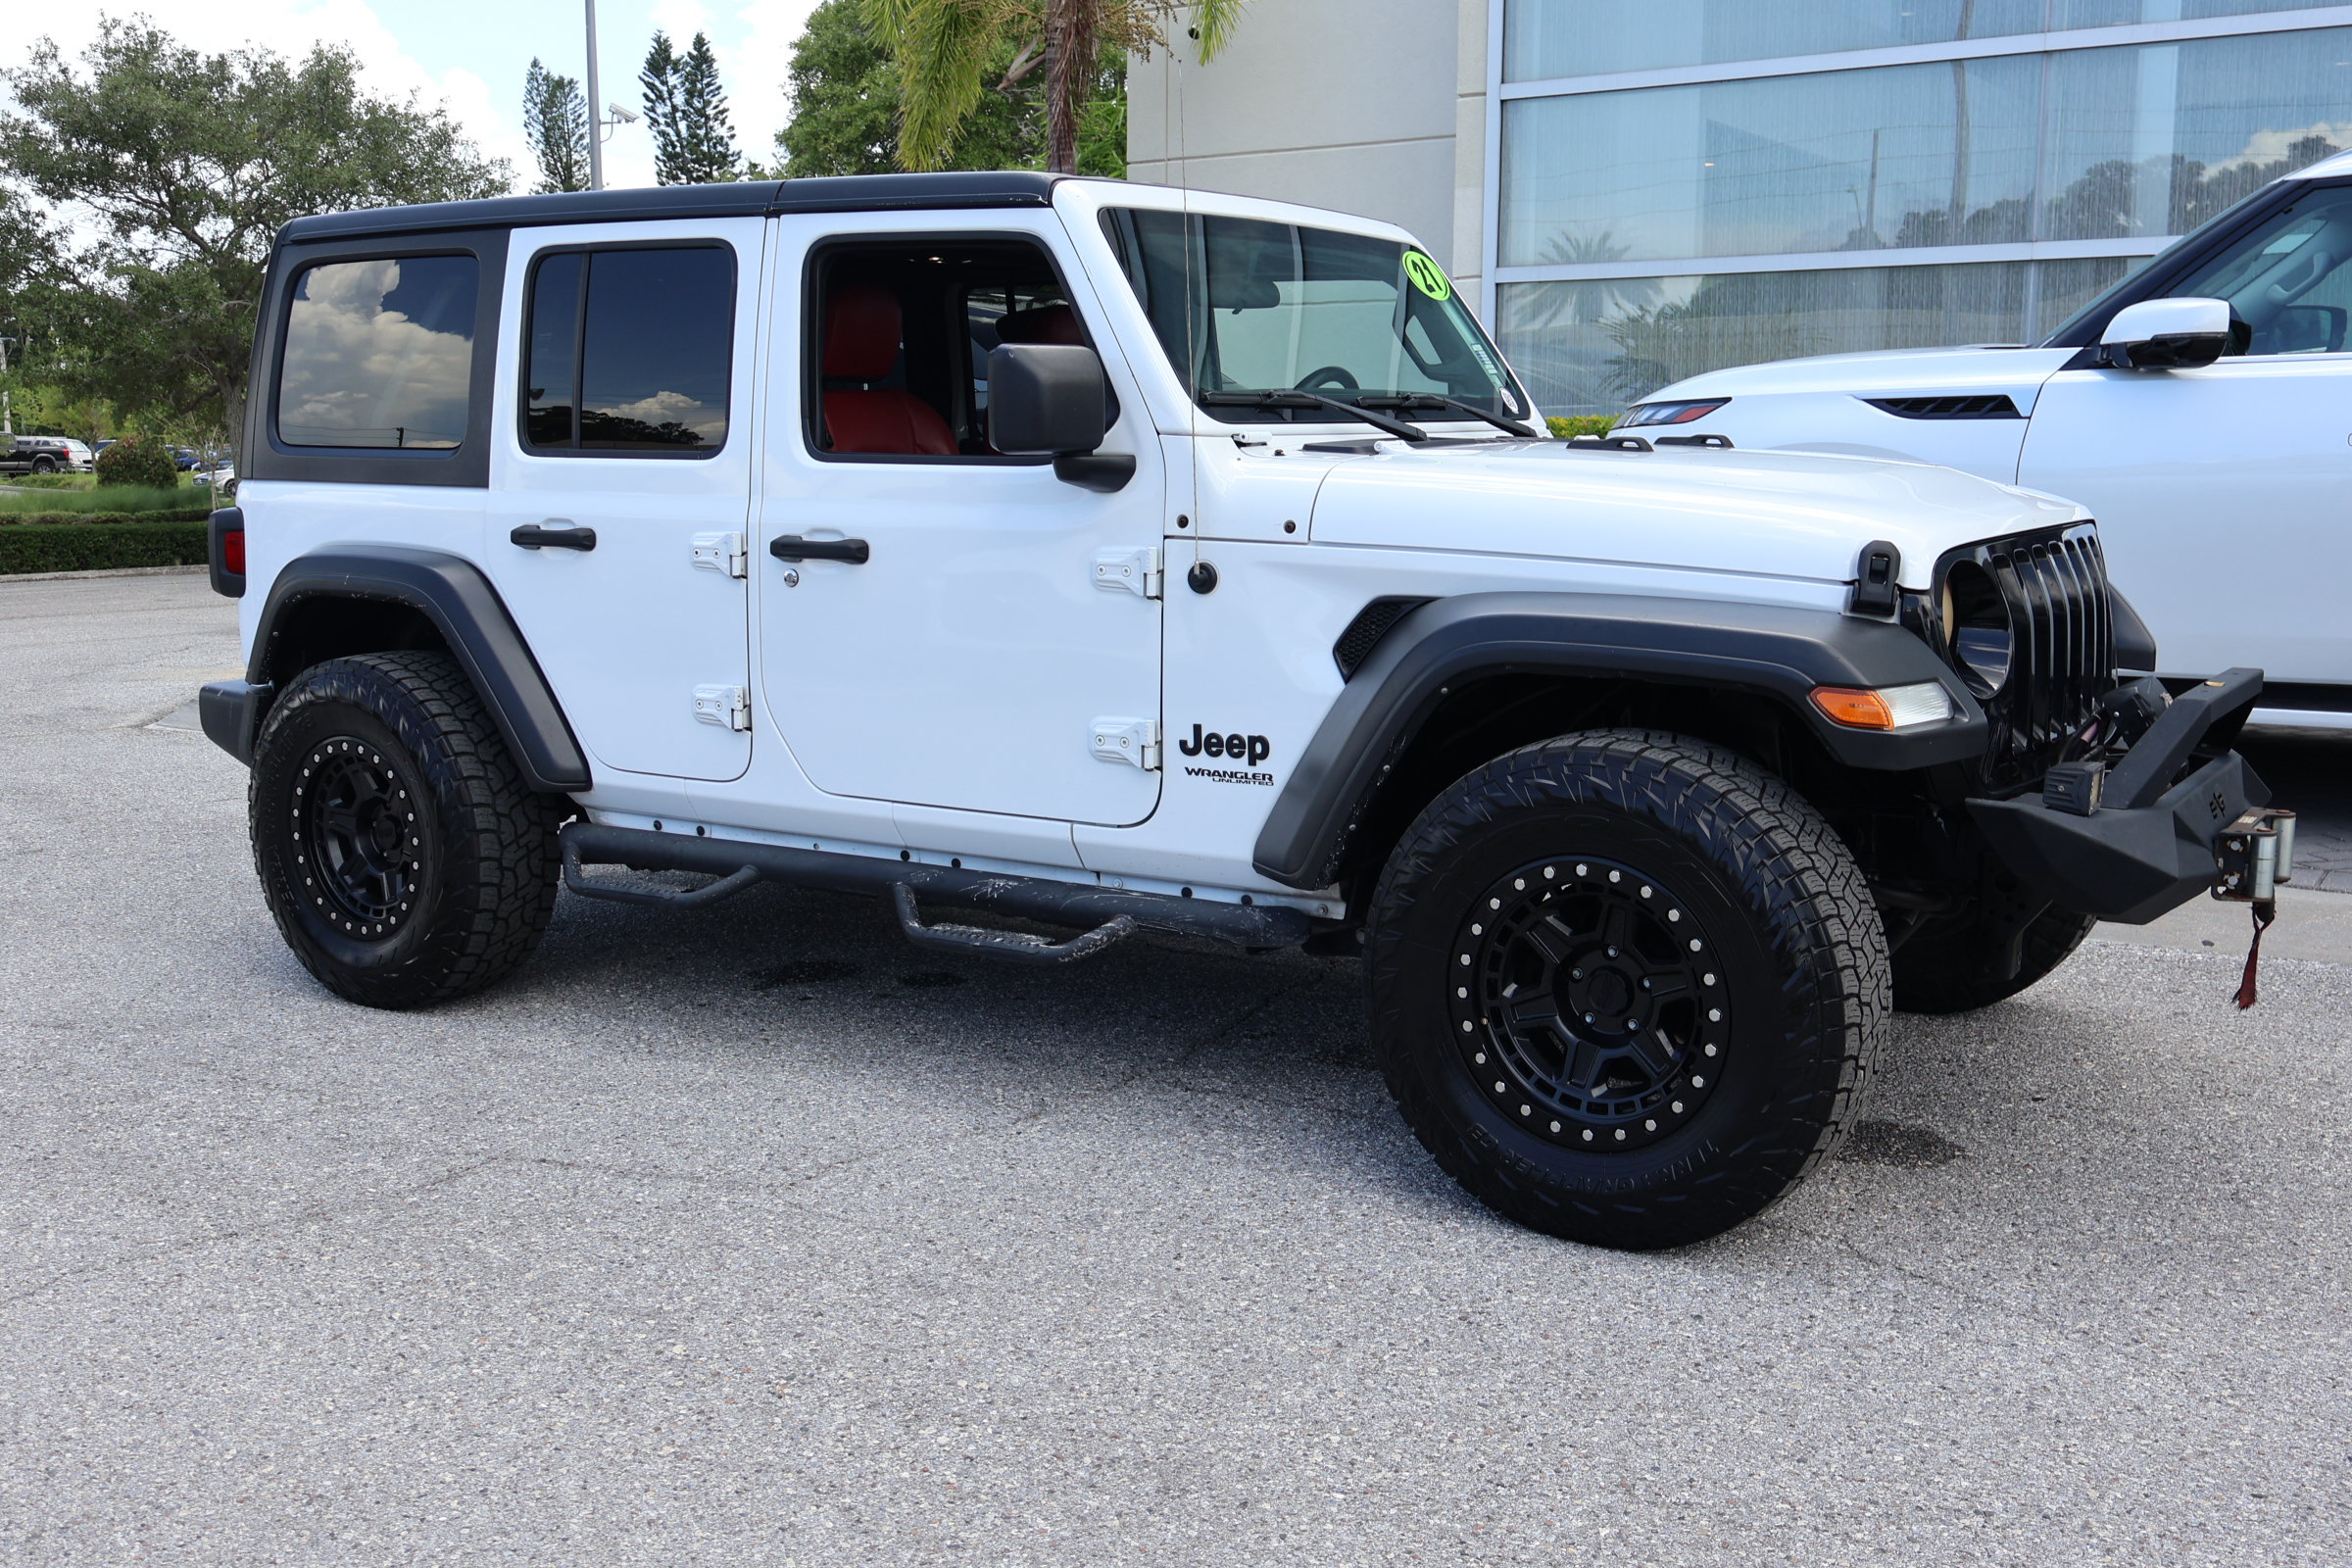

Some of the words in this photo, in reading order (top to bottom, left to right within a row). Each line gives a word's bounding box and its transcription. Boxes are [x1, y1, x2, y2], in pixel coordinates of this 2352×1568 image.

[1411, 258, 1444, 293] 21
[1179, 723, 1270, 766] Jeep
[1184, 766, 1273, 782] WRANGLER
[1212, 777, 1274, 786] UNLIMITED
